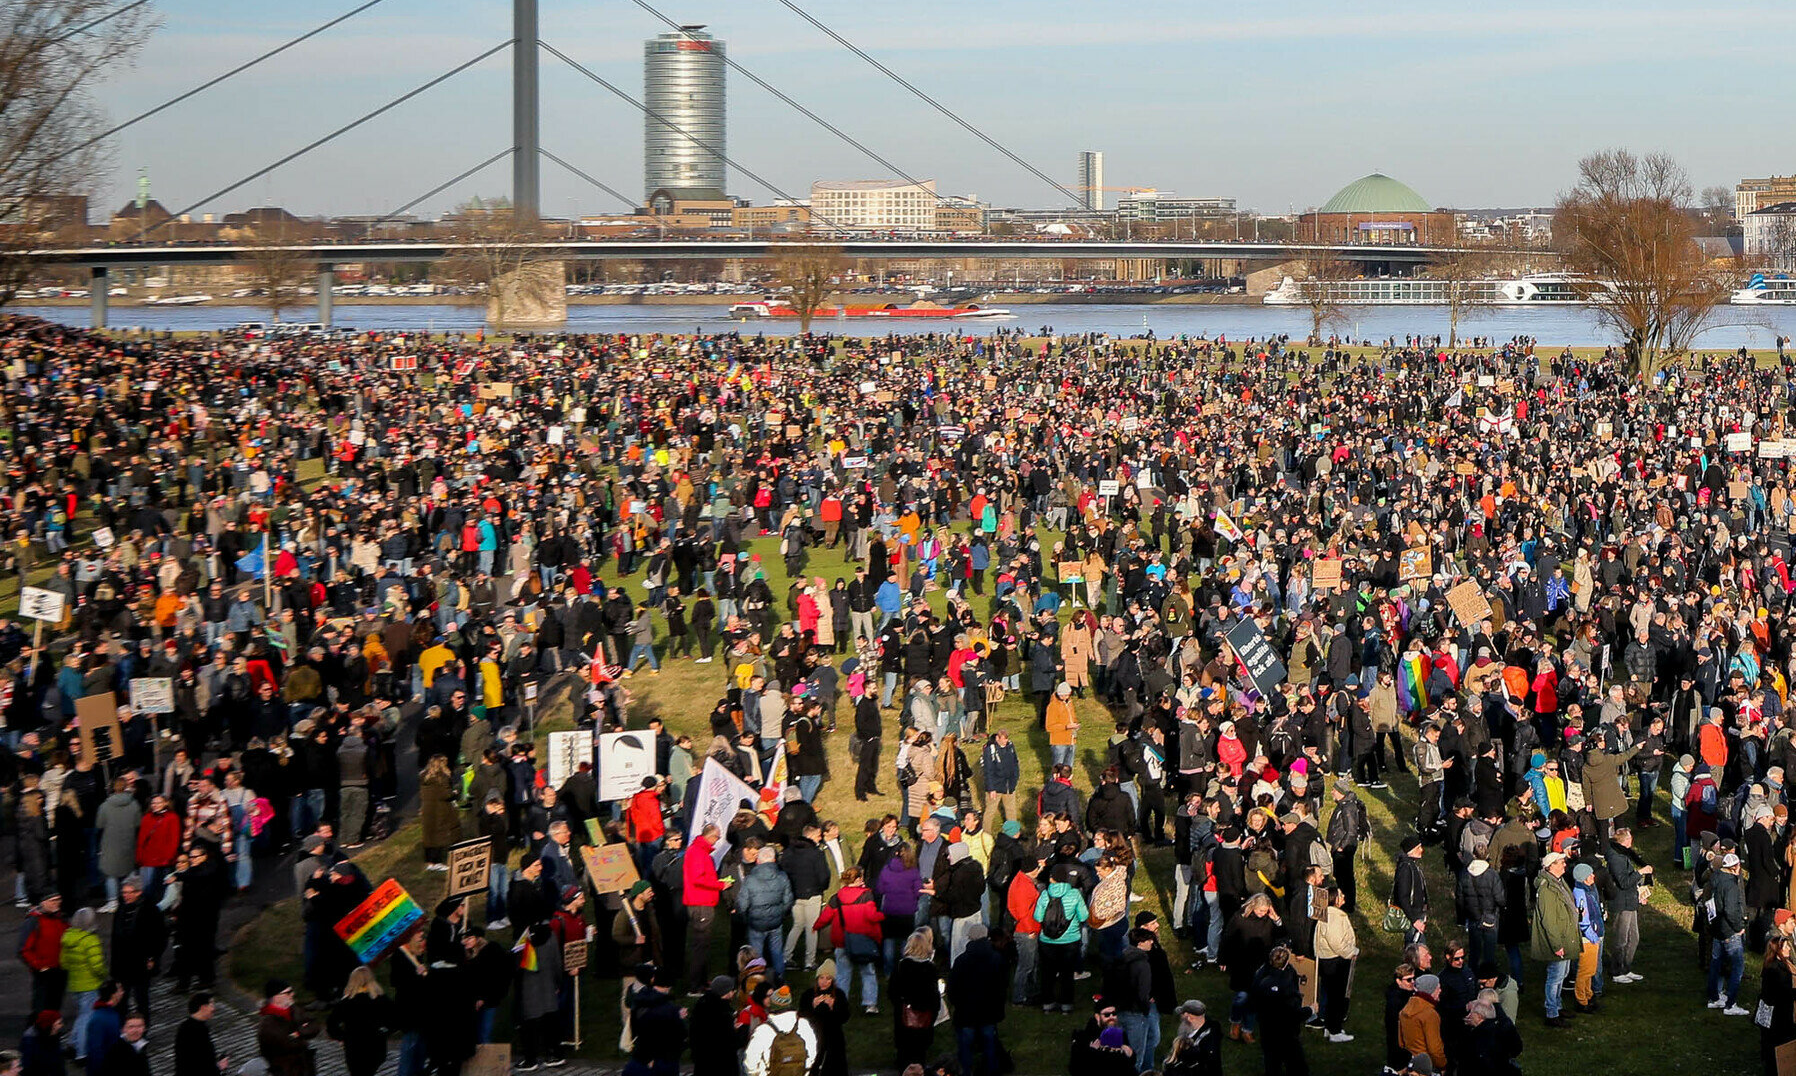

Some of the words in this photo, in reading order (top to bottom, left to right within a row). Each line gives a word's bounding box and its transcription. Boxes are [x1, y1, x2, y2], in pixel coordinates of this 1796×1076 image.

[1239, 632, 1262, 657] liberté
[1252, 663, 1267, 678] fck
[1264, 653, 1277, 668] afd
